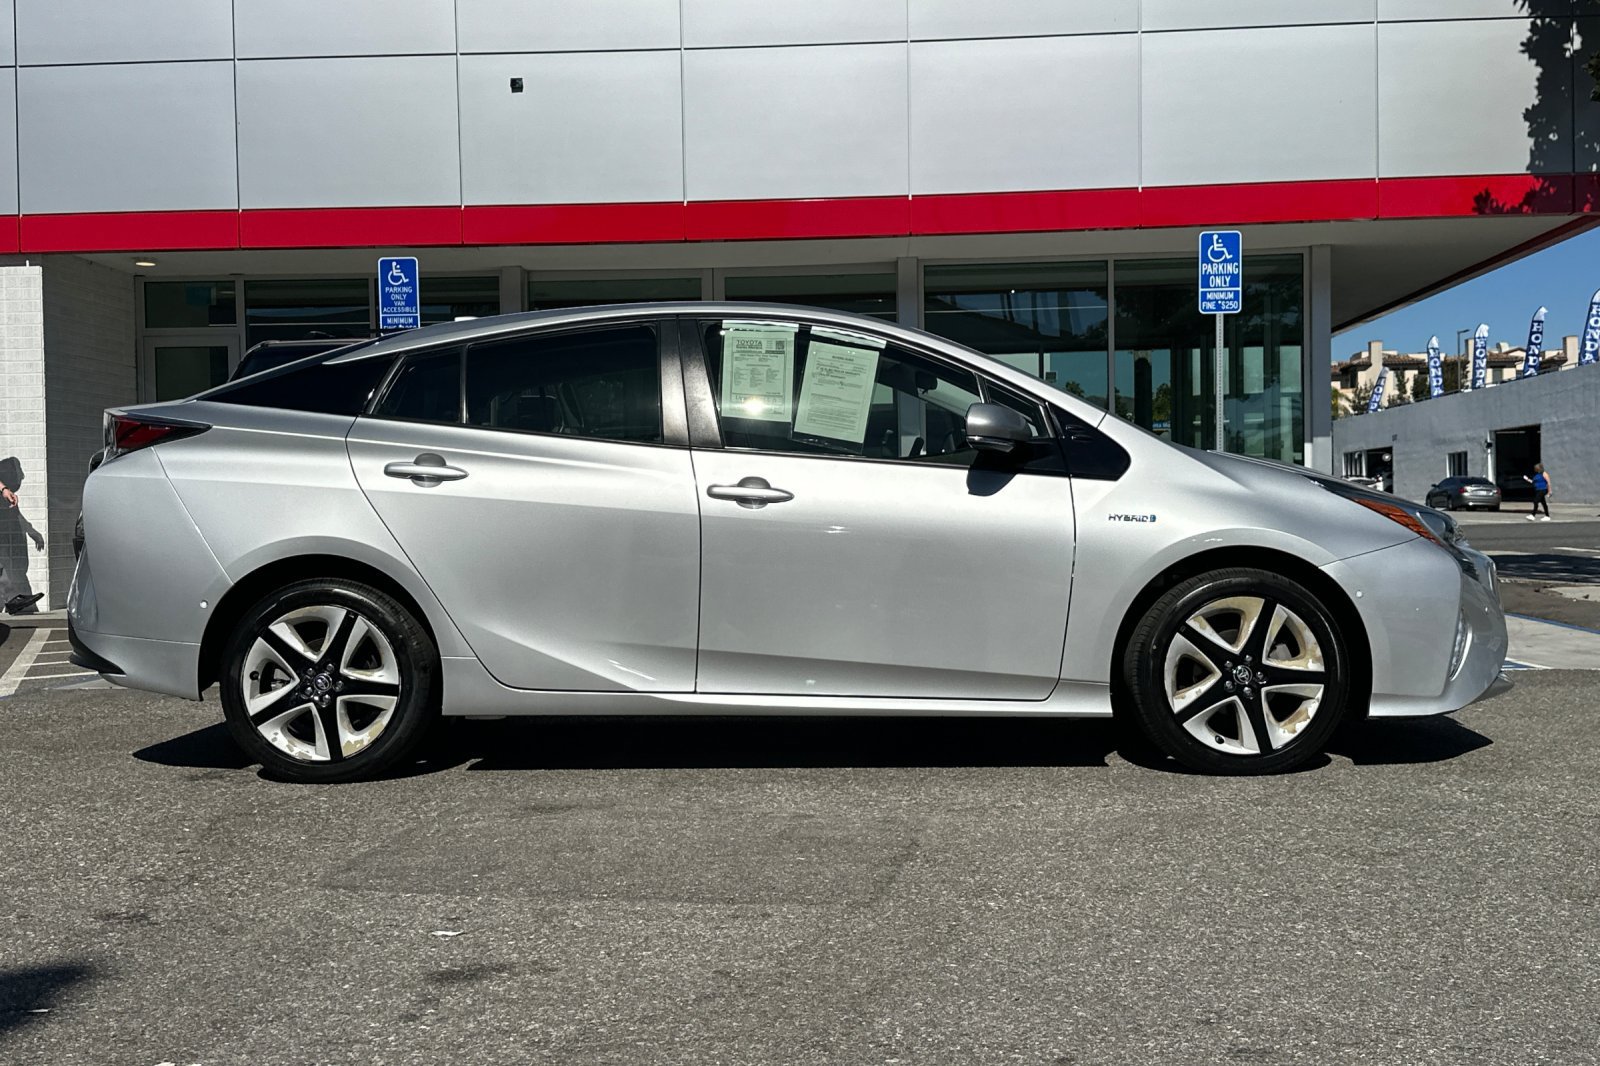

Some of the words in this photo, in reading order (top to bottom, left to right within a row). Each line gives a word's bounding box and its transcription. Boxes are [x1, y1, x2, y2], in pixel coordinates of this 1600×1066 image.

[1202, 263, 1239, 275] PARKING
[1209, 275, 1231, 288] ONLY
[385, 286, 413, 294] PARKING
[1206, 292, 1234, 300] MINIMUM
[390, 293, 407, 301] ONLY
[1202, 301, 1216, 310] FINE
[1581, 304, 1600, 364] HONDA
[1524, 322, 1543, 376] HONDA
[1475, 338, 1487, 387] HONDA
[1429, 348, 1444, 396] HONDA
[1108, 513, 1149, 522] HYBRID
